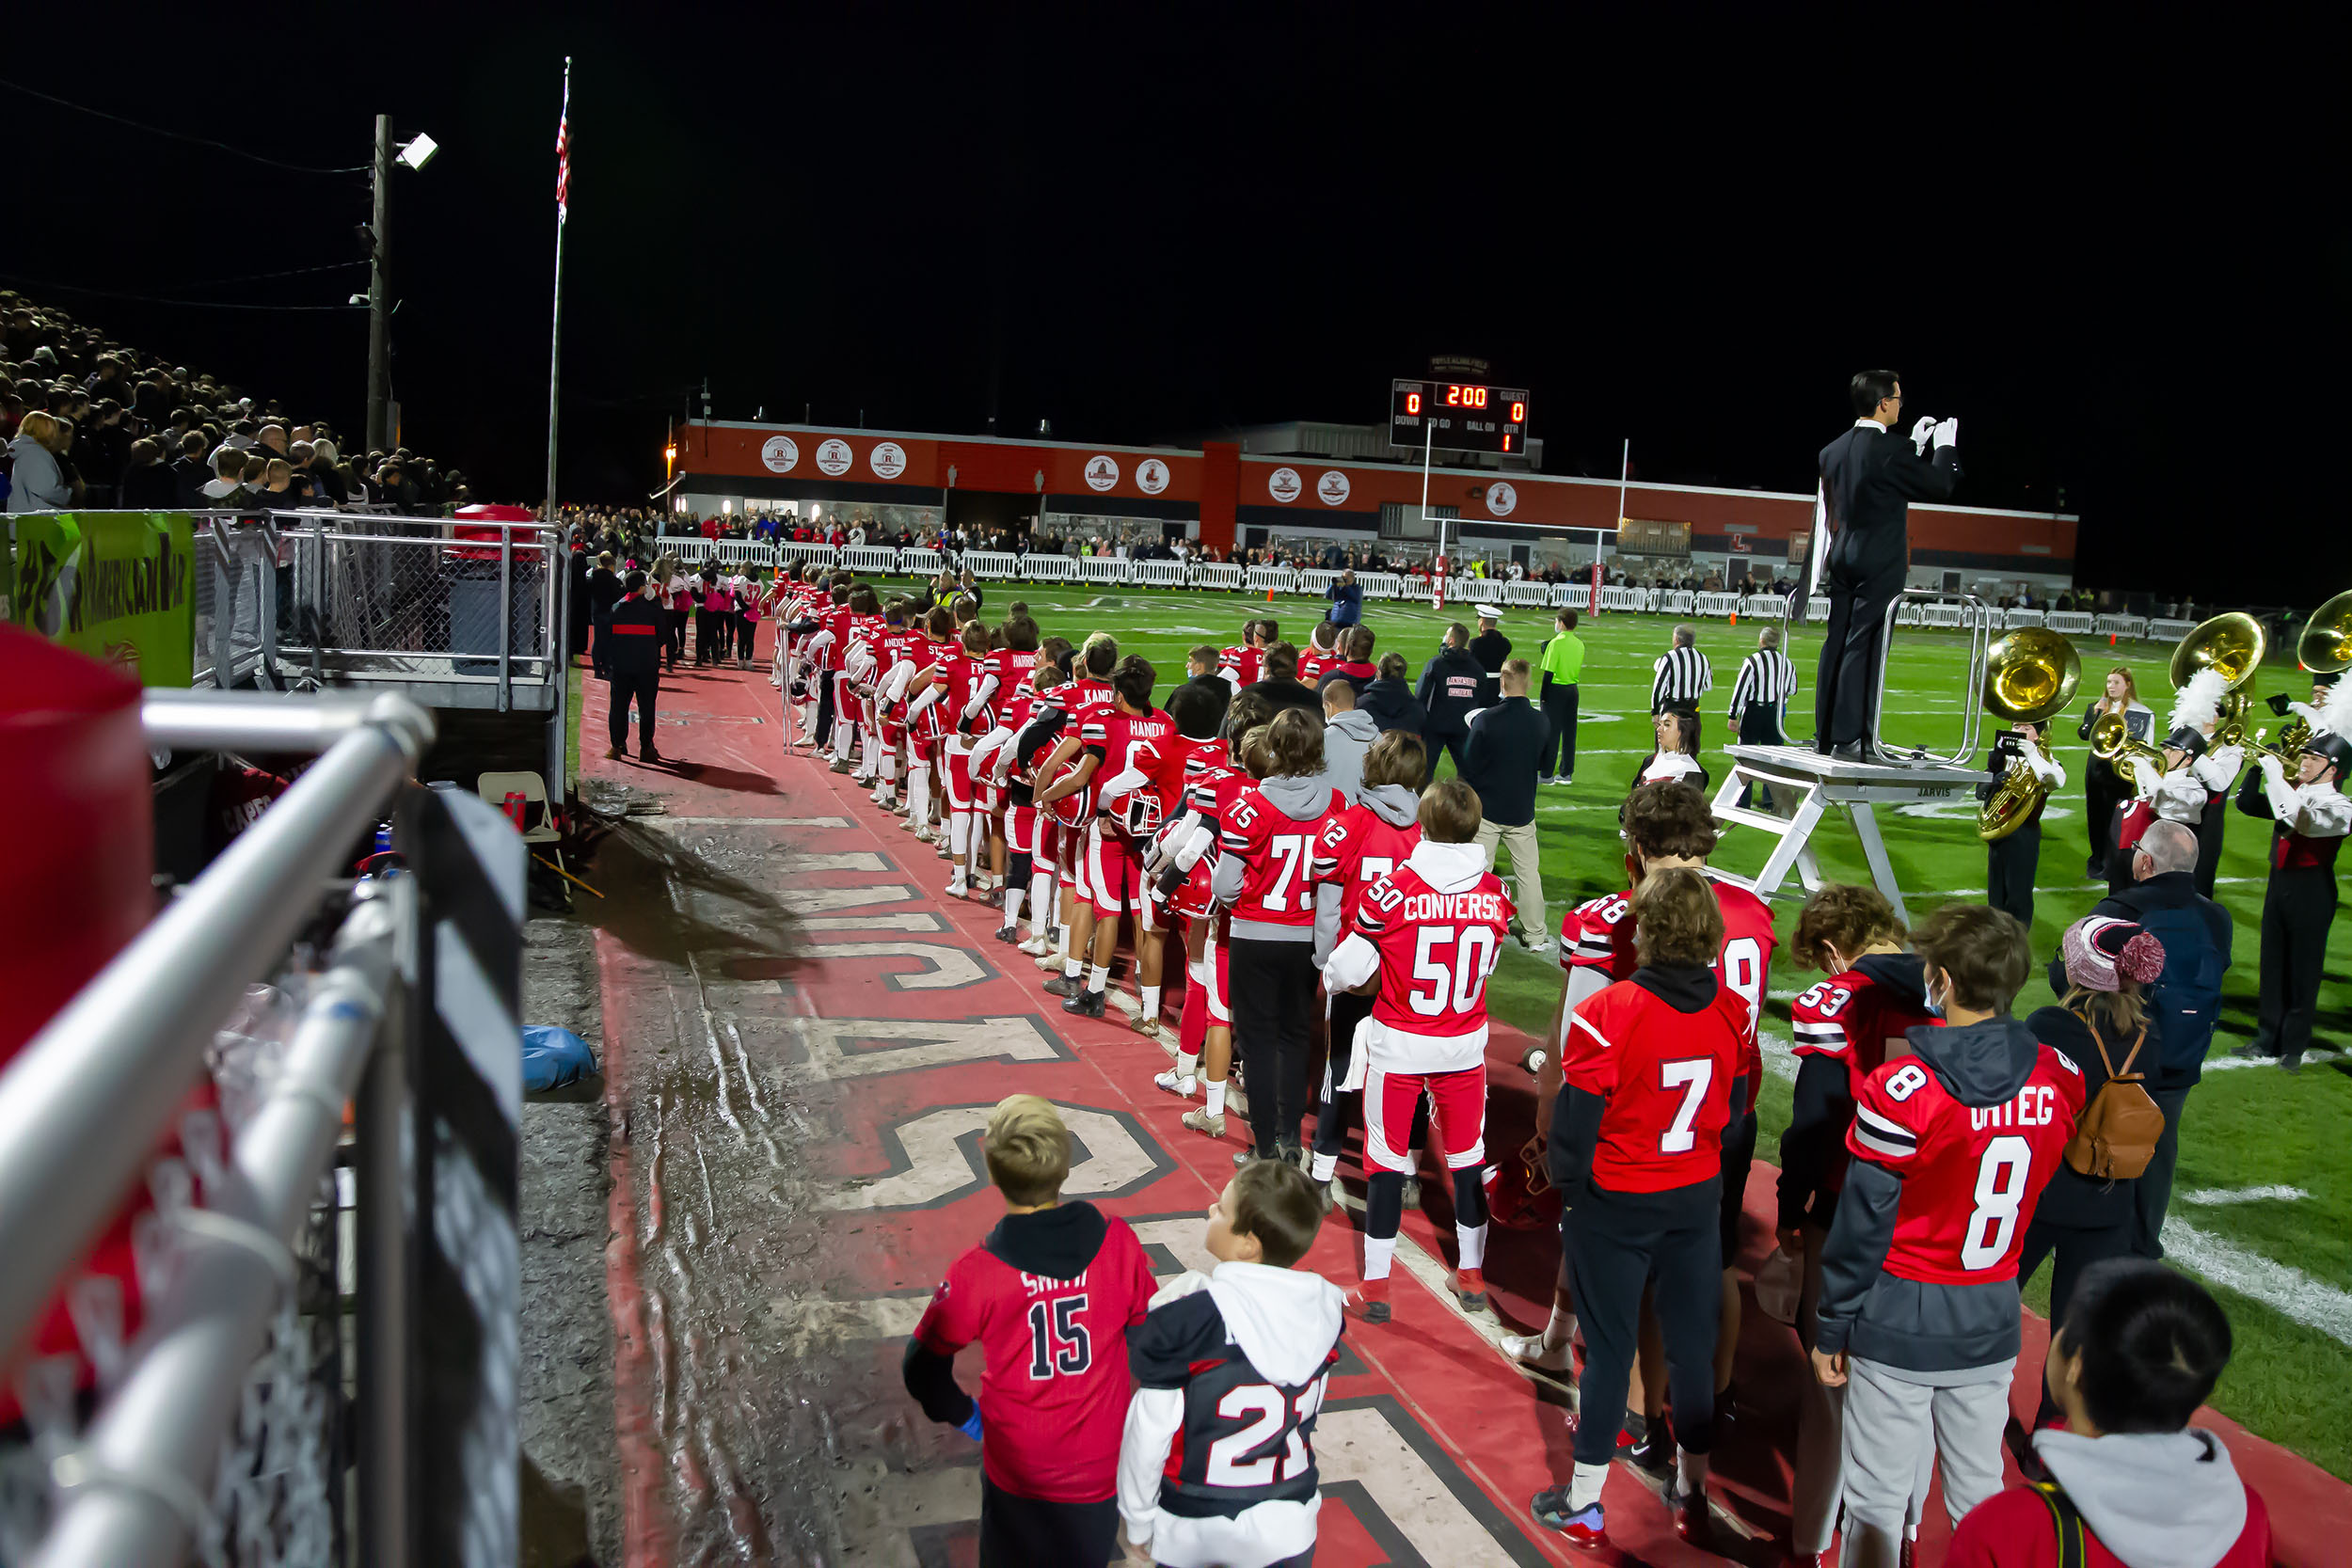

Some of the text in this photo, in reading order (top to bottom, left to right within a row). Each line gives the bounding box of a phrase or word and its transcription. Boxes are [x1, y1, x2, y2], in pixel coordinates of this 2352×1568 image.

[1407, 393, 1421, 413] 0
[1500, 390, 1526, 402] GUEST
[1394, 415, 1420, 426] DOWN
[1427, 417, 1451, 429] TO GO
[1466, 420, 1496, 432] BALL ON
[1512, 403, 1524, 422] 0
[1503, 423, 1519, 434] QTR
[744, 583, 761, 603] 32
[1084, 689, 1114, 704] KAND
[1129, 720, 1166, 737] HANDY
[1917, 787, 1951, 798] JARVIS
[1229, 798, 1259, 829] 75
[1323, 817, 1348, 849] 72
[1367, 876, 1405, 913] 50
[1404, 893, 1502, 922] CONVERSE
[1590, 893, 1629, 925] 68
[1408, 925, 1496, 1017] 50
[1798, 981, 1851, 1018] 53
[1885, 1064, 1928, 1101] 8
[1659, 1054, 1714, 1156] 7
[1961, 1135, 2032, 1270] 8
[1028, 1293, 1092, 1381] 15
[1203, 1377, 1321, 1488] 21
